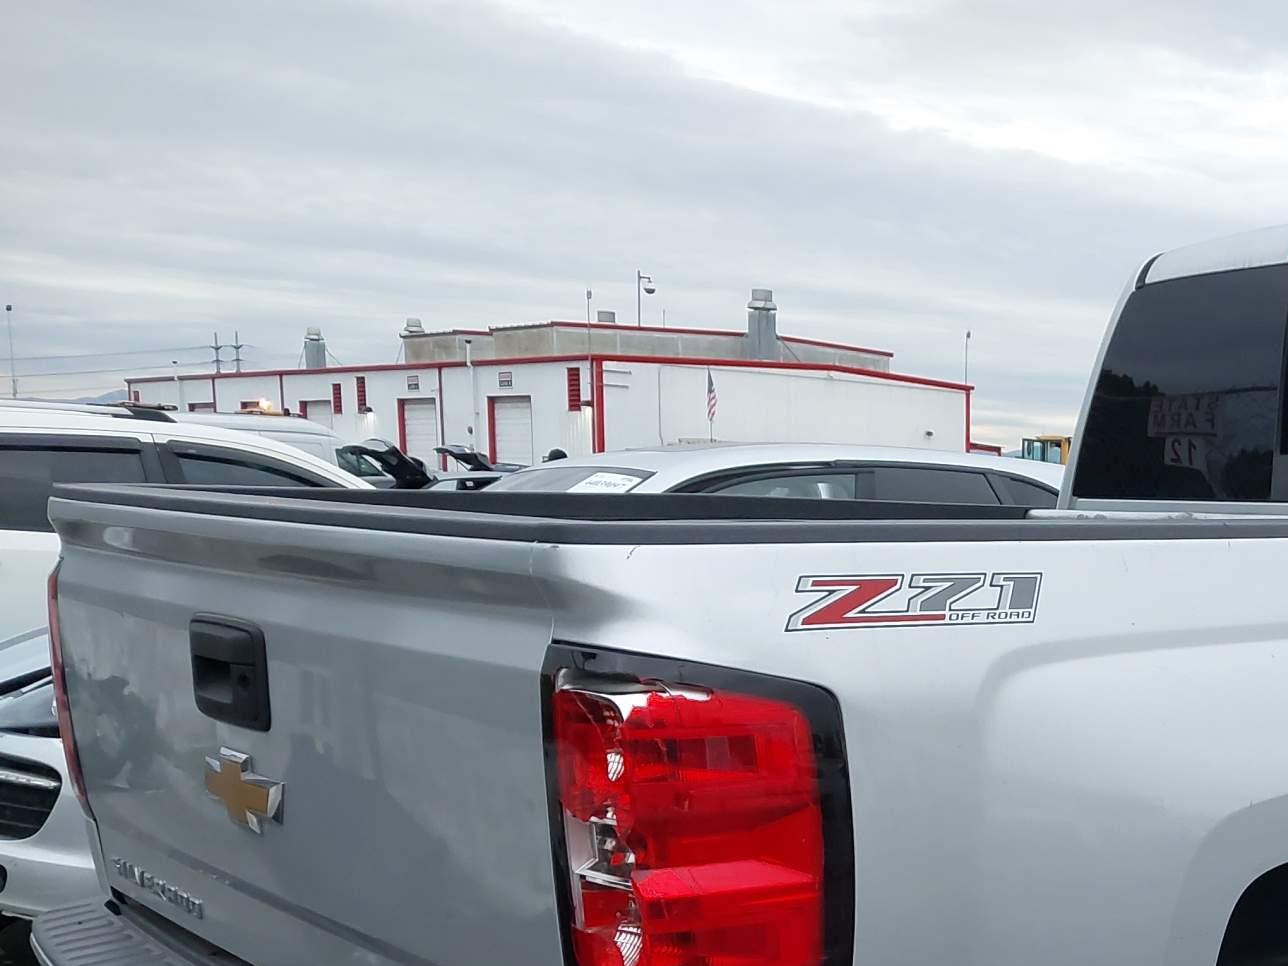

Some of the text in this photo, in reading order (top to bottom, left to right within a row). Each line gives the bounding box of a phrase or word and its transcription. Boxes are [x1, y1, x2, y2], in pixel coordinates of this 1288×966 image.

[785, 572, 1043, 632] Z71
[949, 611, 1031, 621] OFF ROAD
